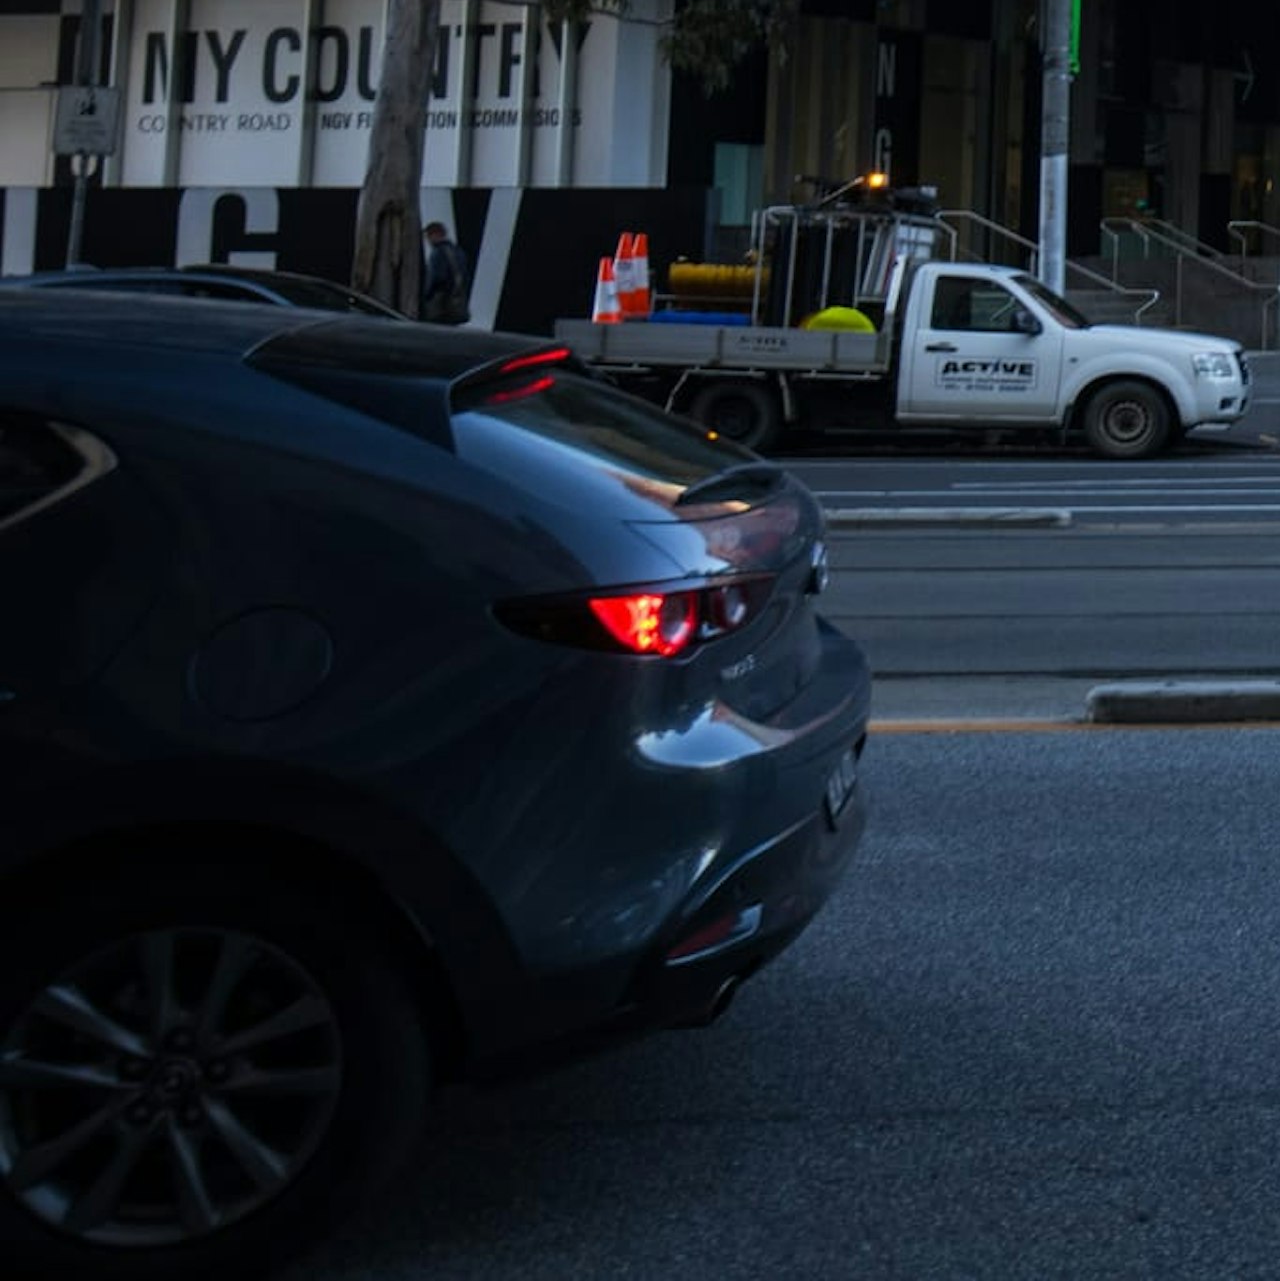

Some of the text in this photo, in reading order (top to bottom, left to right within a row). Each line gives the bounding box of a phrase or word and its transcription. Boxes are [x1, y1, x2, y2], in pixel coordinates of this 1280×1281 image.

[142, 29, 248, 105] MY
[238, 113, 291, 131] ROAD
[942, 360, 1036, 377] ACTIVE
